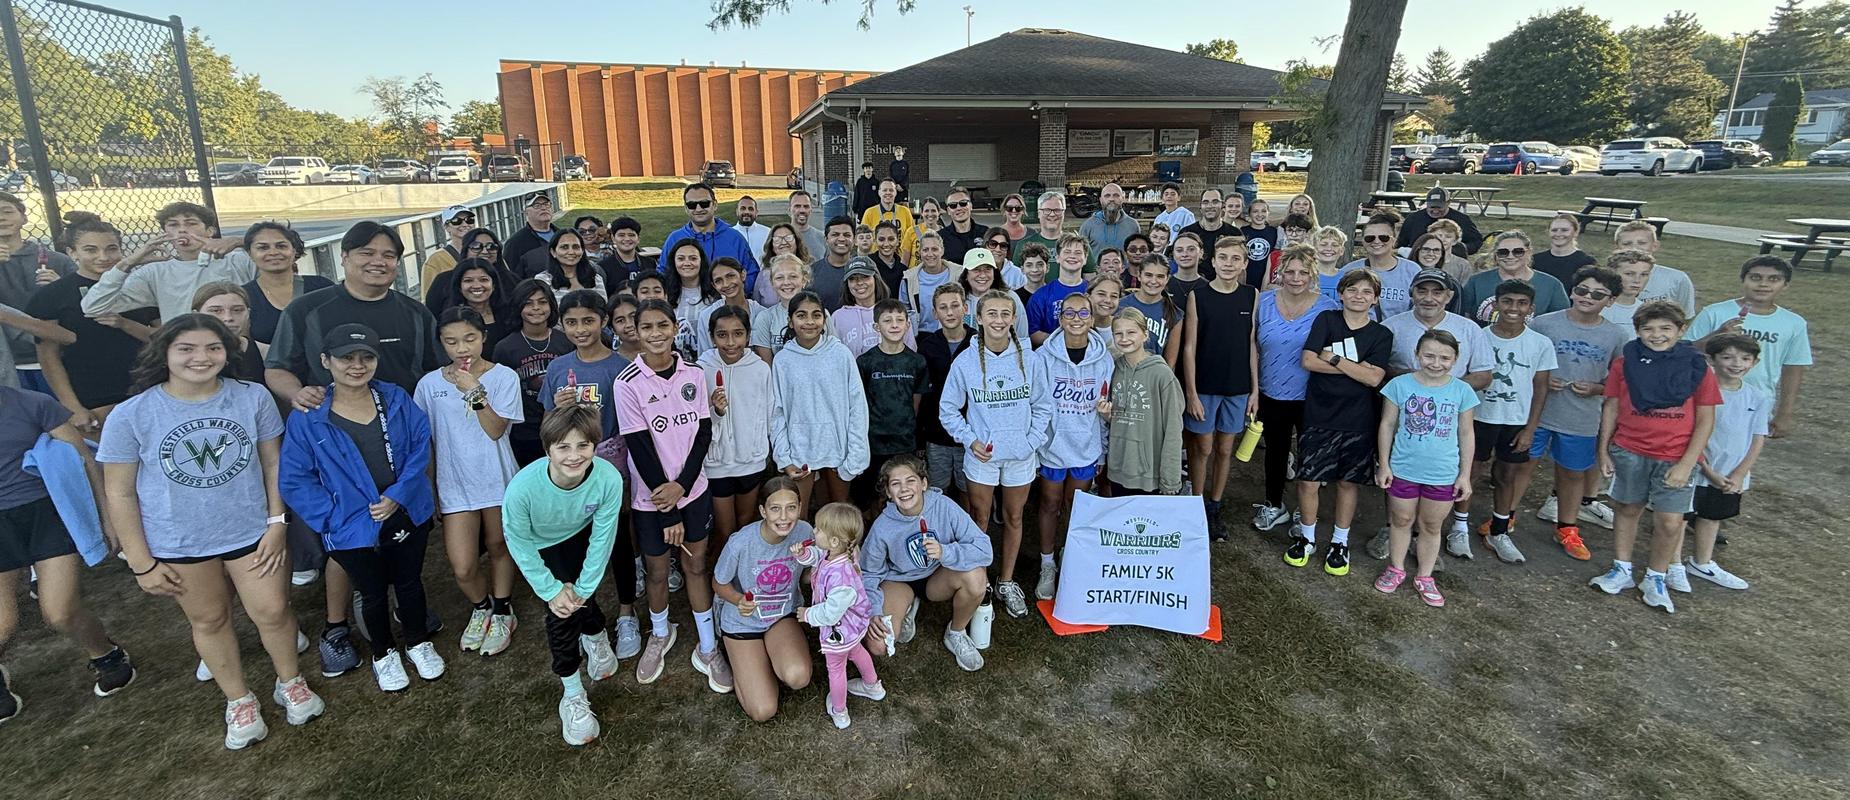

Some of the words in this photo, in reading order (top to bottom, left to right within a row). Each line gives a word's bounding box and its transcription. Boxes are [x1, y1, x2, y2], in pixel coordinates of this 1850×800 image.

[871, 144, 907, 154] Sheltr
[521, 352, 559, 365] NATIONA
[515, 358, 548, 382] OOTBALL
[872, 371, 915, 380] Champion
[433, 390, 449, 398] 2025
[971, 383, 1031, 403] WARRIORS
[161, 421, 205, 460] WESTFIELD
[209, 420, 250, 447] WARRIORS
[168, 469, 203, 487] CROSS
[206, 457, 248, 486] COUNTRY
[1099, 527, 1182, 549] WARRIORS
[1135, 548, 1160, 556] COUNTRY
[1101, 564, 1153, 580] FAMILY
[1156, 566, 1176, 581] 5K
[1086, 589, 1188, 610] START/FINISH
